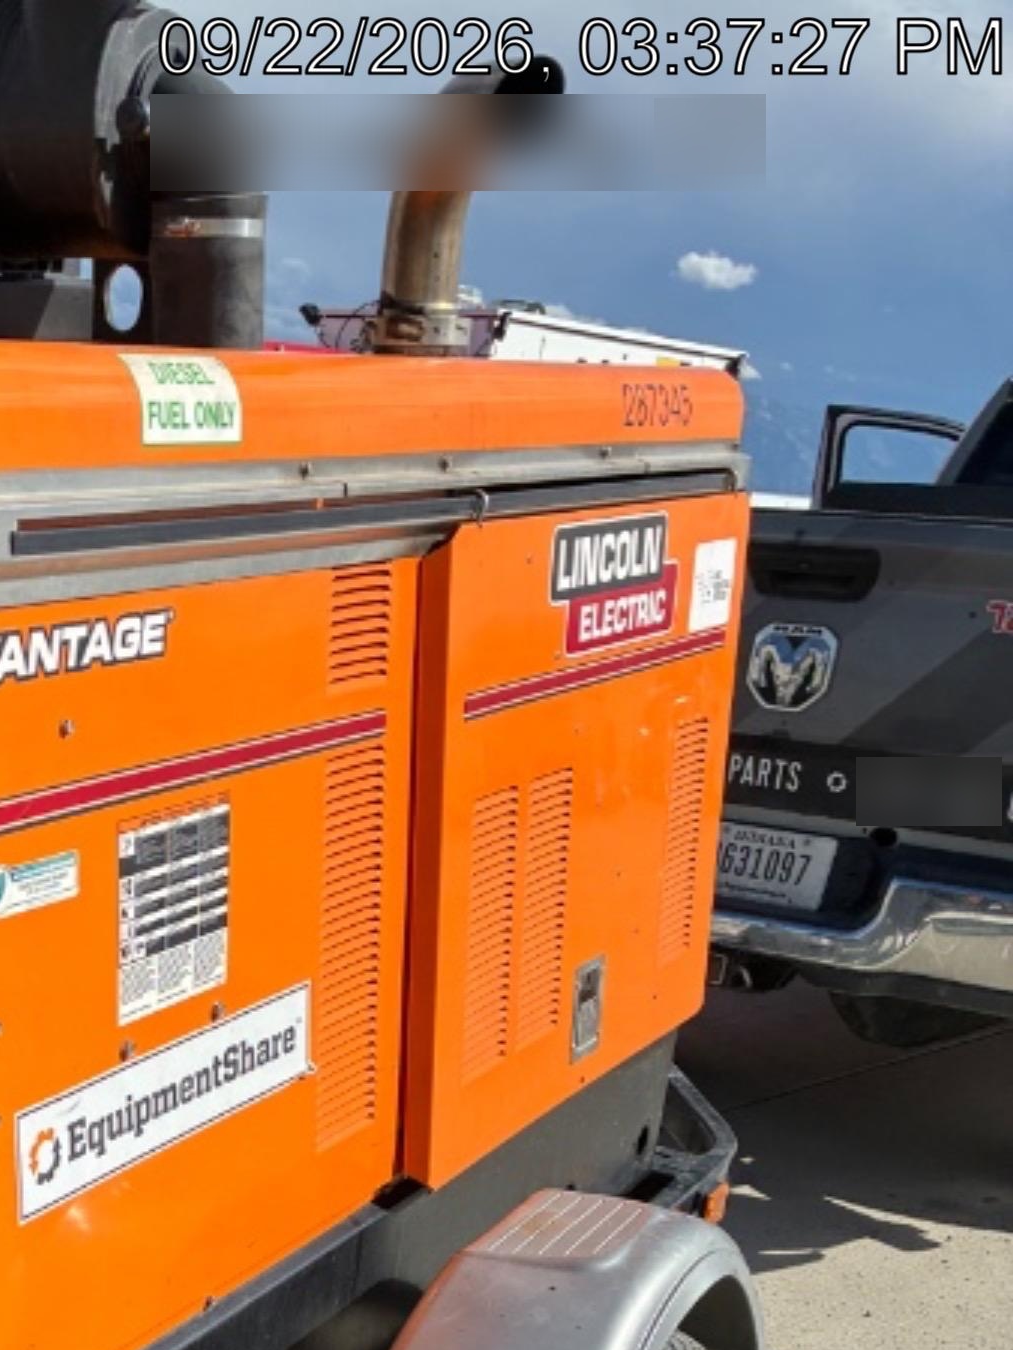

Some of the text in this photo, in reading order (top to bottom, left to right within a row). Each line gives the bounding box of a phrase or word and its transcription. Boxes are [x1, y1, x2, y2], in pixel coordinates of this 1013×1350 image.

[148, 362, 215, 385] DIESEL
[147, 401, 237, 430] FUEL ONLY
[622, 383, 694, 428] 287345
[556, 524, 663, 593] LINCOLN
[577, 588, 667, 644] ELECTRIC
[727, 753, 803, 792] PARTS
[717, 841, 813, 887] 631097
[67, 1022, 297, 1164] EquipmentShare
